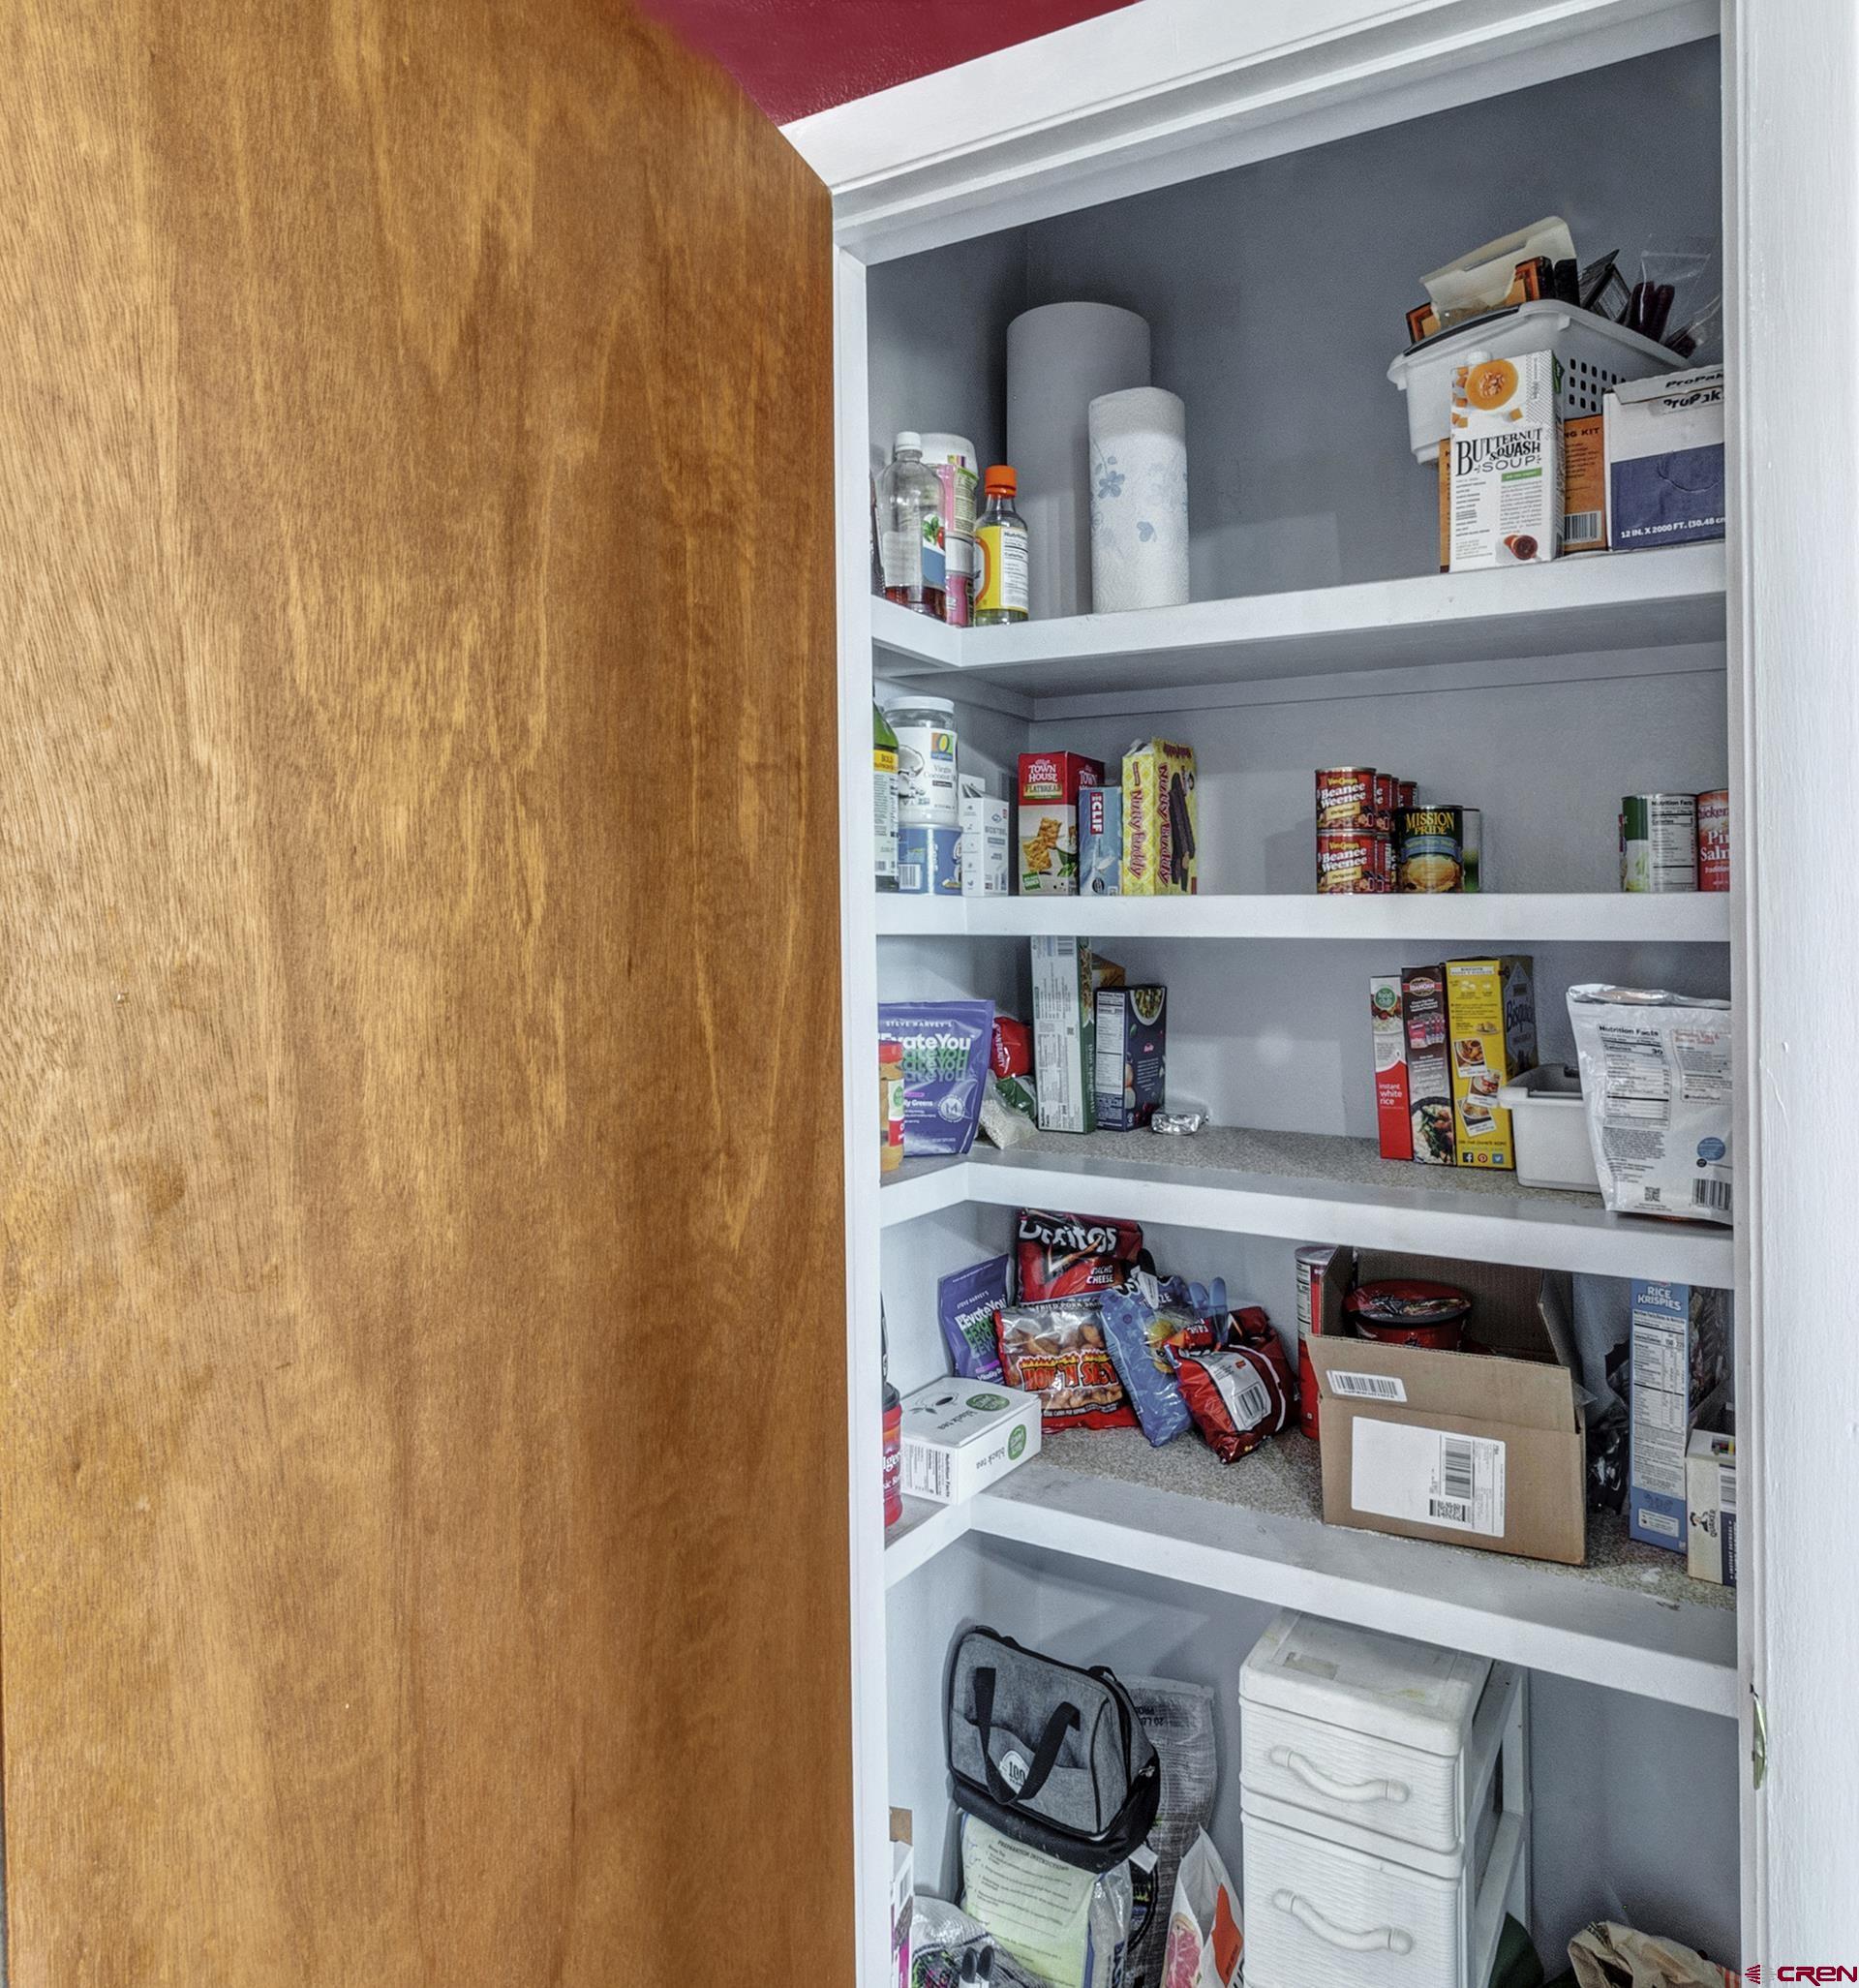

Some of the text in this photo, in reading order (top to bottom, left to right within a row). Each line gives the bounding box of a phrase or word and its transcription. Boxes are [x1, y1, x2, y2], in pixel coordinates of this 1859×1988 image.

[1581, 426, 1600, 437] KIT
[1455, 427, 1543, 477] BUTTERNUT
[1490, 440, 1541, 461] SQUASH
[1481, 455, 1536, 474] SOUP
[1621, 530, 1631, 538] 12
[1652, 523, 1673, 535] 2000
[1673, 520, 1688, 532] FT.
[1028, 763, 1057, 775] TOWN
[1028, 772, 1058, 784] HOUSE
[1321, 781, 1366, 800] Beanee
[1320, 790, 1367, 810] Weenee
[1091, 802, 1104, 834] CLIF
[1405, 811, 1455, 832] MISSION
[1414, 827, 1448, 836] PRIDE
[1322, 847, 1367, 863] Beanee
[1321, 856, 1368, 872] Weenee
[1599, 1025, 1660, 1037] Nutrition Facts
[1380, 1089, 1403, 1099] white
[1380, 1096, 1395, 1106] rice
[1019, 1219, 1117, 1253] Doritos
[1085, 1273, 1114, 1285] CHEESE
[1647, 1286, 1672, 1300] RICE
[1637, 1294, 1682, 1311] KRISPIES
[1021, 1366, 1056, 1392] HOT
[1708, 1509, 1718, 1538] QUAKER
